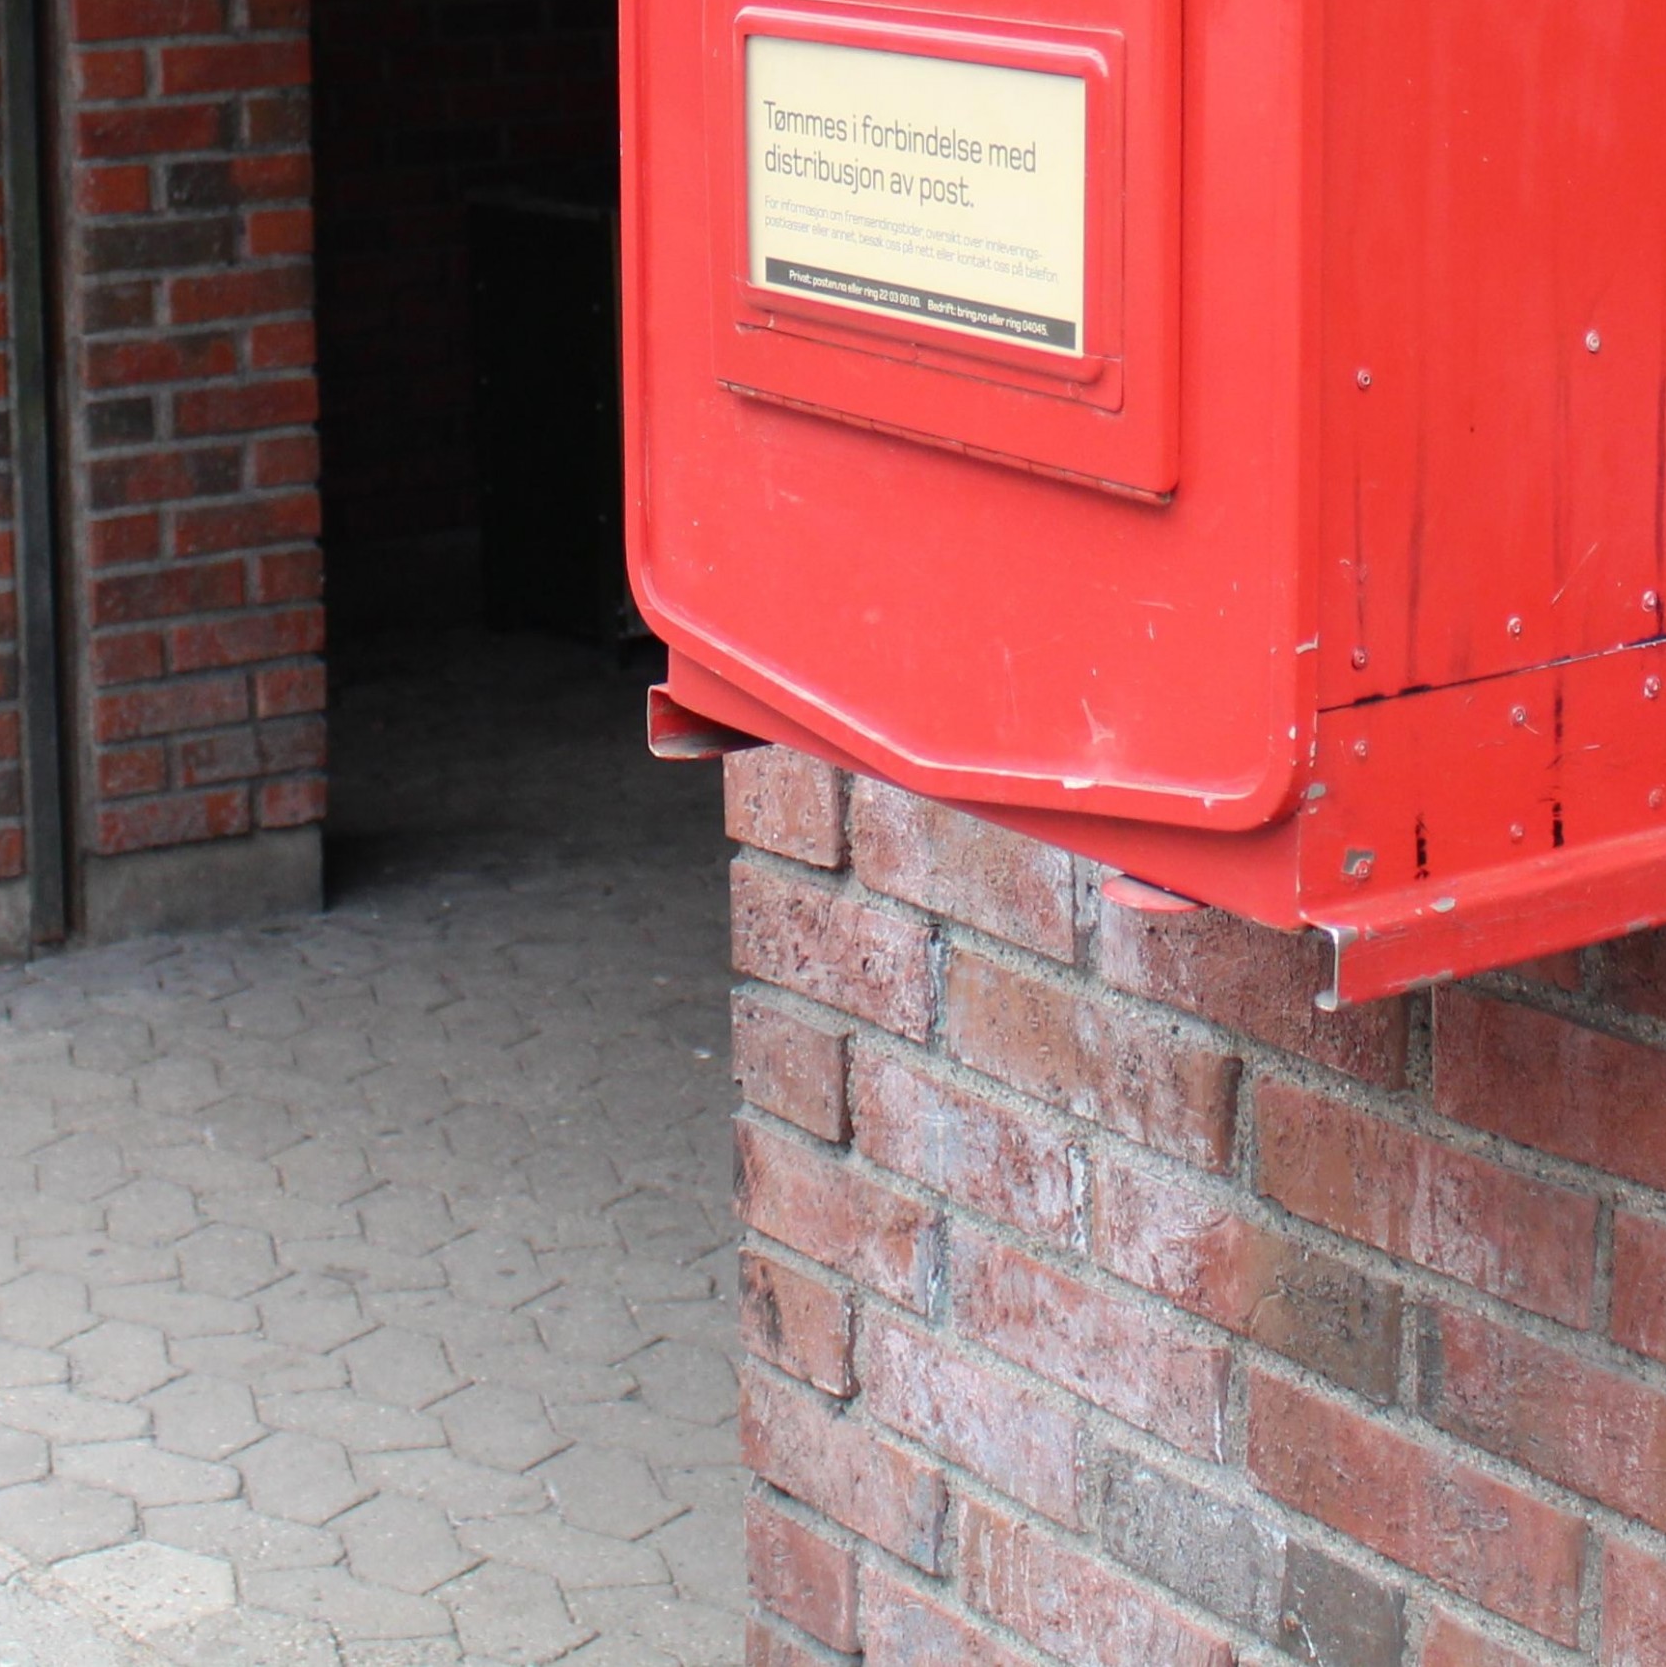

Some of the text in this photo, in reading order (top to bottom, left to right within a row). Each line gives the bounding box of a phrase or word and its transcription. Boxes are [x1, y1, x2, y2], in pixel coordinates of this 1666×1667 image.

[763, 100, 1036, 173] Tømmes i forbindelse med
[765, 143, 974, 208] distribusjon av post.
